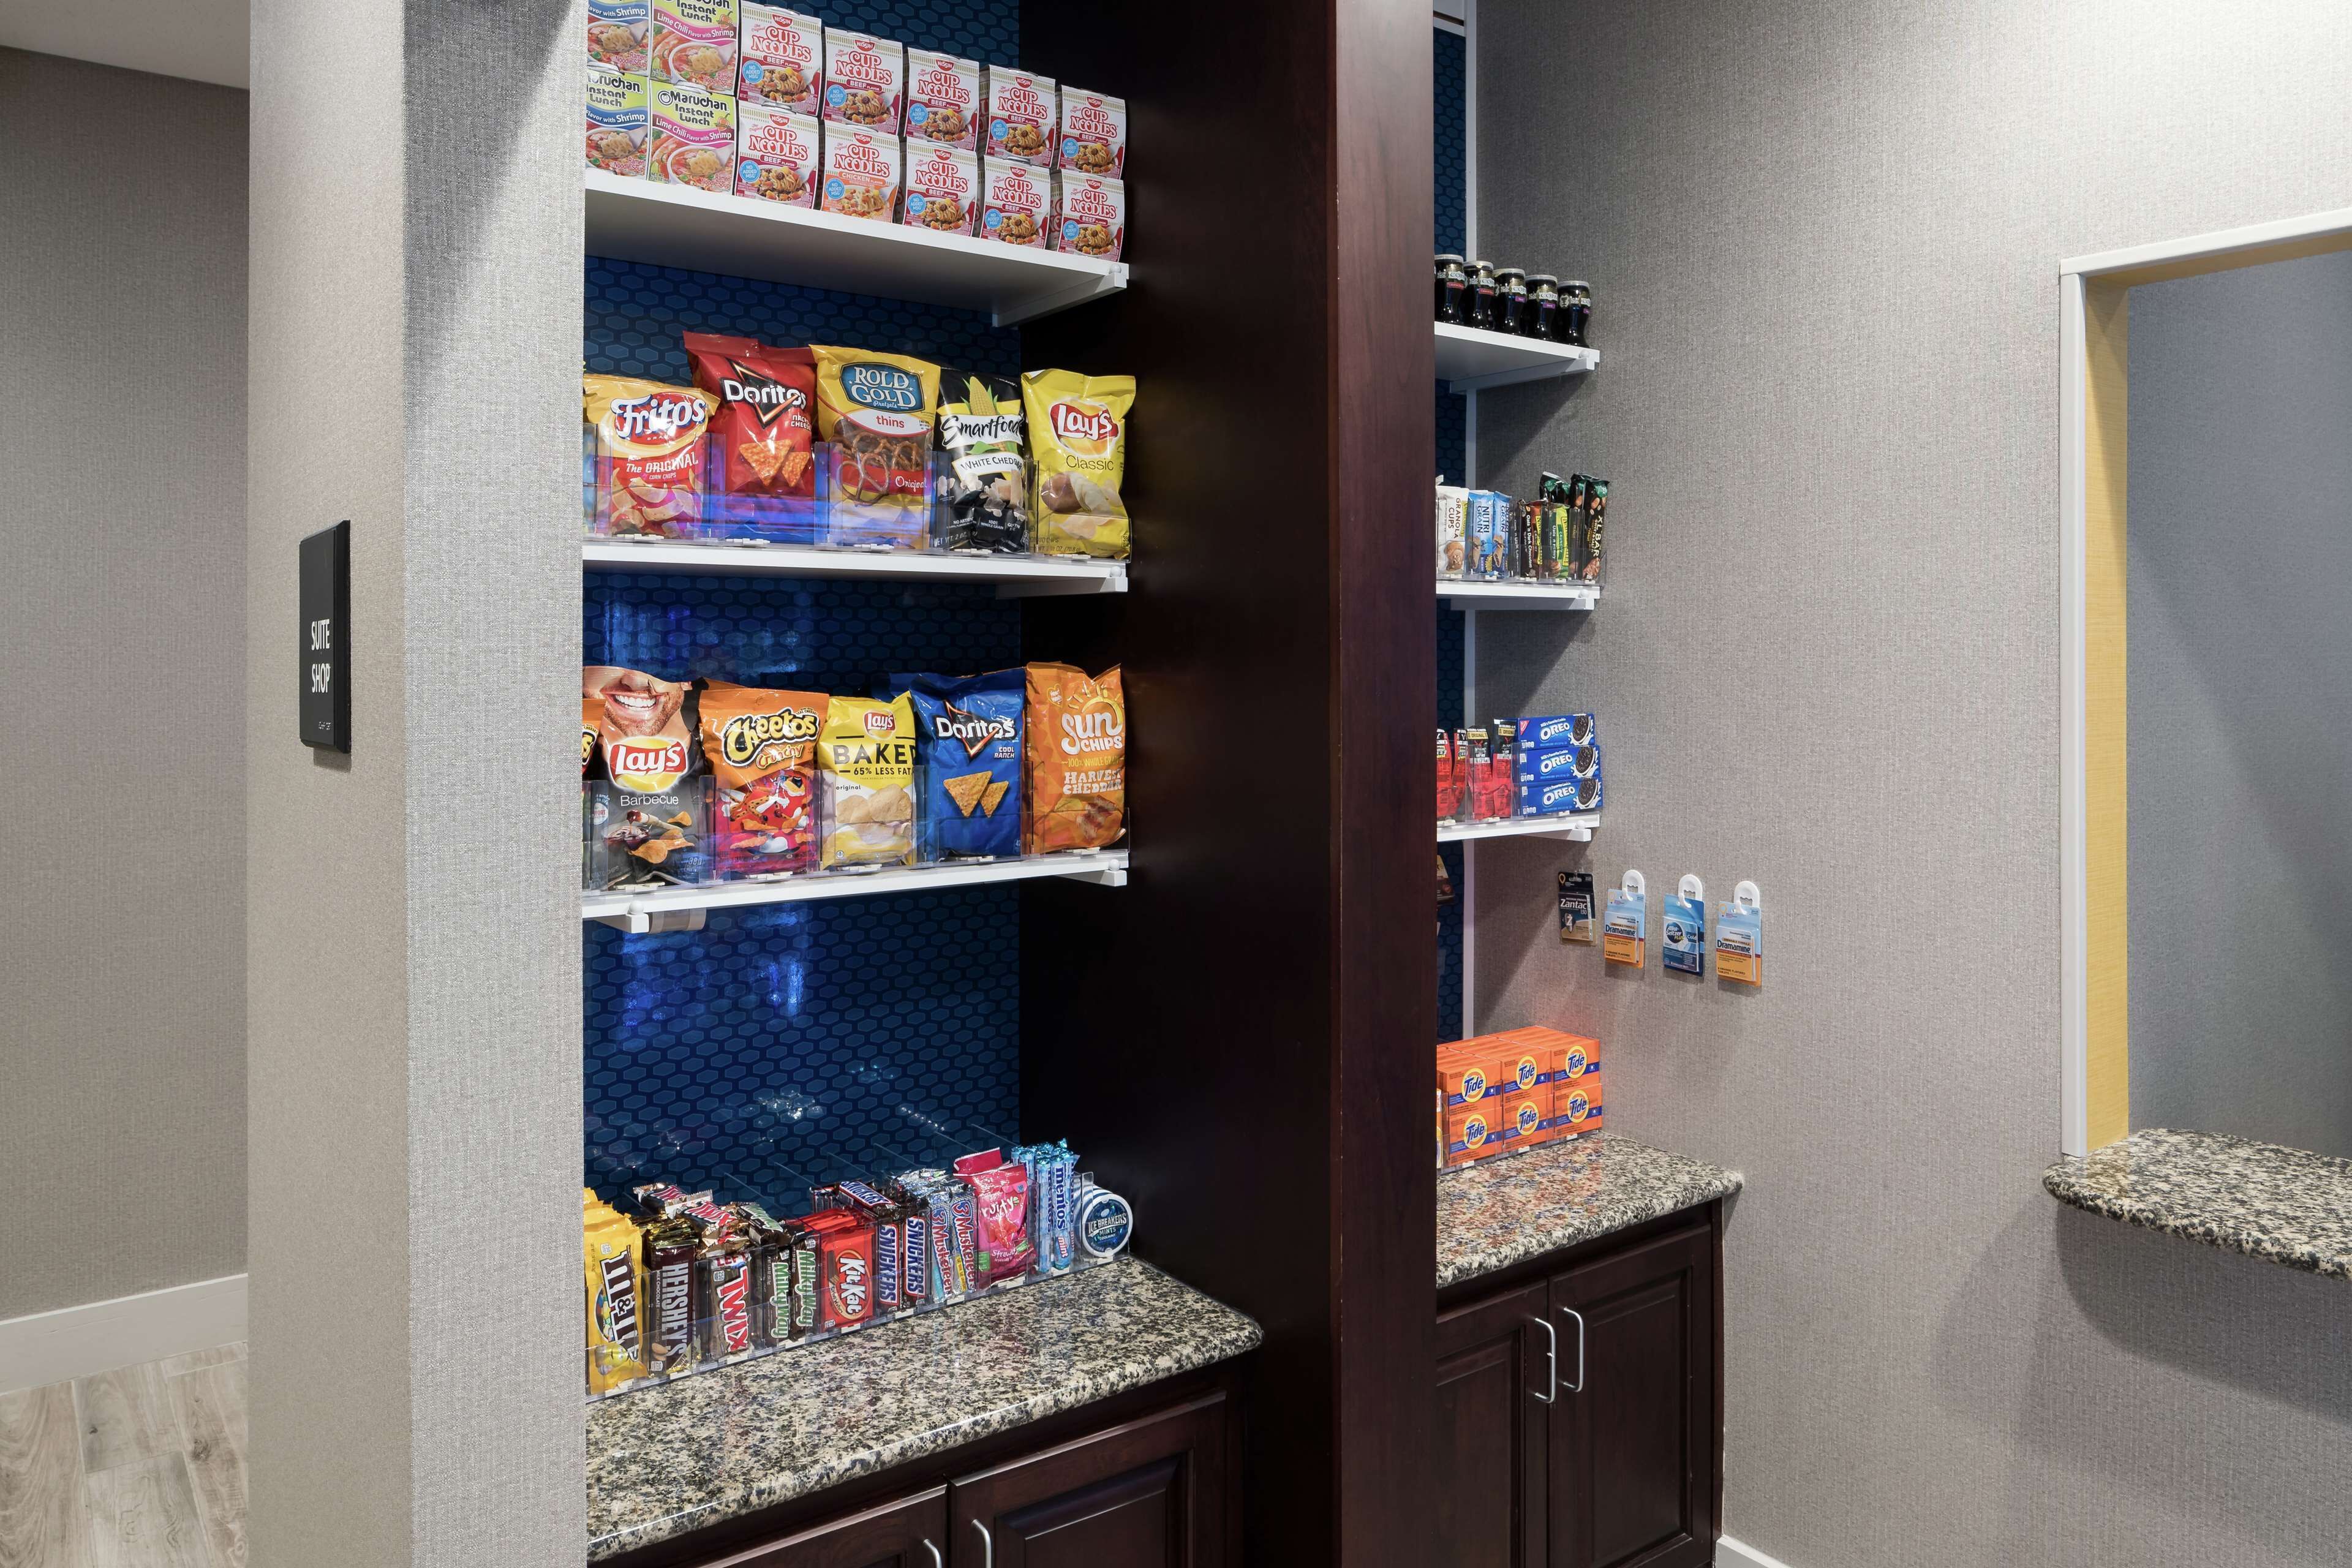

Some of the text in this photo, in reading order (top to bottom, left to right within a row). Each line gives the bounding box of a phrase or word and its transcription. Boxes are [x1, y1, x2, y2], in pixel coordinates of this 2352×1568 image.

[617, 7, 646, 17] Shrimp
[677, 1, 717, 15] Instant
[681, 9, 712, 23] Lunch
[657, 13, 674, 25] Lime
[674, 22, 688, 34] Chili
[774, 16, 791, 24] NISSIN
[766, 26, 801, 43] CUP
[752, 36, 812, 62] NOODLES
[849, 51, 881, 67] CUP
[835, 60, 892, 85] NOODLES
[930, 70, 960, 88] CUP
[589, 93, 622, 107] Lunch
[671, 91, 727, 111] Maruchan
[918, 80, 970, 104] NOODLES
[1010, 88, 1038, 104] CUP
[675, 104, 714, 118] Instant
[998, 96, 1047, 119] NOODLES
[1081, 107, 1108, 123] CUP
[616, 113, 645, 123] Shrimp
[679, 113, 710, 126] Lunch
[1069, 115, 1117, 138] NOODLES
[656, 118, 672, 130] Lime
[673, 126, 687, 137] Chili
[710, 132, 731, 141] Shrimp
[763, 126, 797, 143] CUP
[749, 135, 808, 160] NOODLES
[848, 143, 880, 160] CUP
[834, 153, 889, 177] NOODLES
[928, 160, 958, 178] CUP
[842, 173, 870, 183] CHICKEN
[915, 170, 968, 192] NOODLES
[1005, 177, 1032, 193] CUP
[993, 186, 1042, 208] NOODLES
[1081, 189, 1107, 204] CUP
[1071, 198, 1116, 219] NOODLES
[854, 366, 909, 389] ROLD
[723, 379, 807, 410] Doritos
[851, 385, 916, 407] GOLD
[873, 400, 897, 409] Pretzels
[611, 394, 706, 439] Fritos
[876, 415, 905, 428] thins
[1058, 404, 1113, 441] Lay's
[941, 415, 1020, 447] Smartfood
[627, 451, 698, 474] The ORIGINAL
[960, 456, 1023, 472] WHITE CHEDDAR
[1066, 455, 1114, 472] Classic
[895, 475, 927, 492] Original
[1597, 515, 1603, 530] XL
[312, 619, 330, 650] SUITE
[312, 663, 330, 693] SHOP
[867, 713, 894, 731] Lay's
[936, 717, 1015, 739] Doritos
[1540, 723, 1570, 740] OREO
[726, 710, 816, 762] Cheetos
[1061, 712, 1123, 755] Sun
[1080, 736, 1123, 752] CHIPS
[616, 745, 681, 775] Lay's
[756, 744, 804, 769] Crunchy
[1068, 756, 1120, 767] 100% WHOLE GRAIN
[1541, 755, 1572, 772] OREO
[854, 767, 911, 775] 65% LESS FAT
[1064, 769, 1122, 785] HARVEST
[1063, 779, 1122, 795] CHEDDAR
[1544, 786, 1575, 805] OREO
[620, 794, 679, 807] Barbecue
[1561, 899, 1587, 909] Zantac
[1605, 924, 1635, 937] Dramamine
[1717, 940, 1751, 954] Dramamine
[1567, 1054, 1585, 1074] Tide
[1518, 1064, 1535, 1085] Tide
[1464, 1076, 1483, 1098] Tide
[1569, 1098, 1587, 1118] Tide
[1518, 1110, 1537, 1130] Tide
[1466, 1123, 1485, 1144] Tide
[1055, 1166, 1066, 1230] mentos
[932, 1209, 946, 1224] 3
[952, 1202, 970, 1216] 3
[1088, 1213, 1127, 1234] ICE BREAKERS
[1099, 1227, 1116, 1235] MINTS
[907, 1216, 925, 1295] SNICKERS
[1058, 1236, 1069, 1259] mint
[880, 1225, 896, 1302] SNICKERS
[794, 1250, 816, 1327] Milky Way
[662, 1262, 688, 1356] HERSHEY'S
[717, 1266, 748, 1352] TWIX
[769, 1262, 790, 1338] Milky Way
